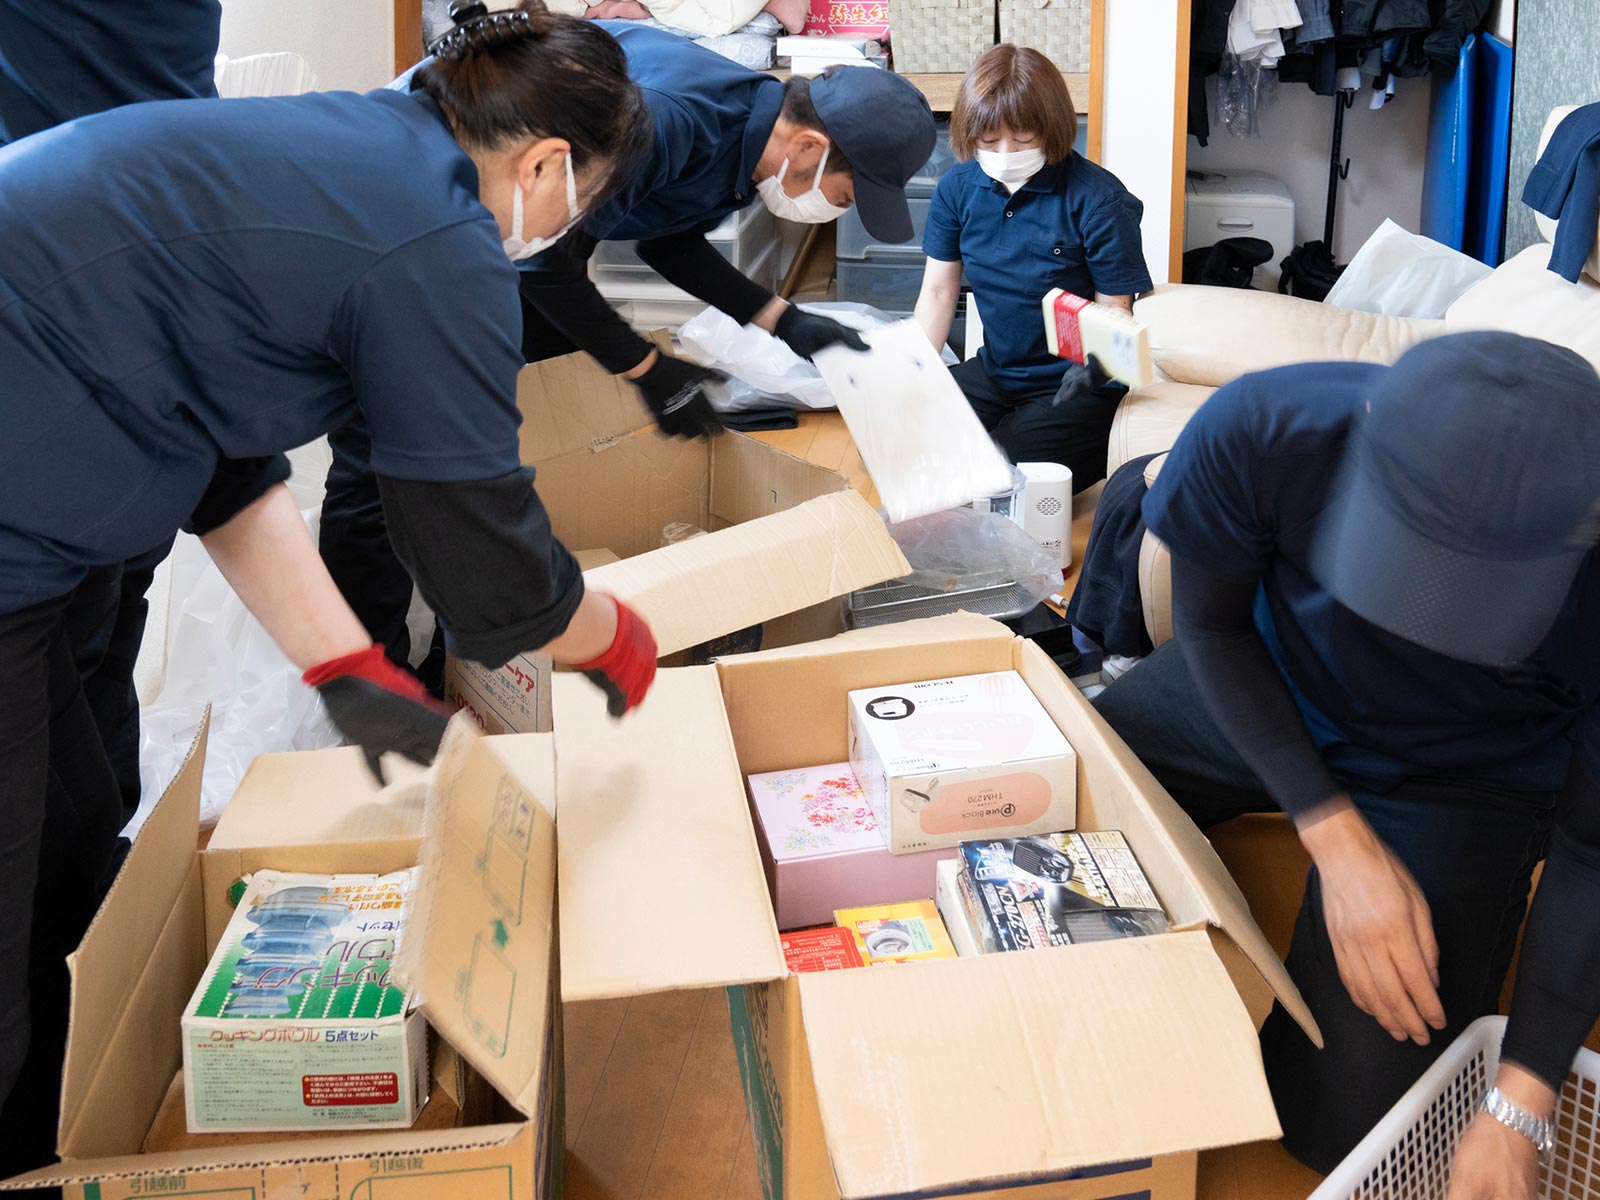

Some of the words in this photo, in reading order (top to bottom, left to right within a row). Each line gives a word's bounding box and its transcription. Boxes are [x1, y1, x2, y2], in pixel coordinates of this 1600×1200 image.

[967, 791, 1003, 804] THM270
[325, 1029, 379, 1043] 5点セット
[369, 1154, 425, 1173] 引越後
[129, 1175, 187, 1193] 引越前
